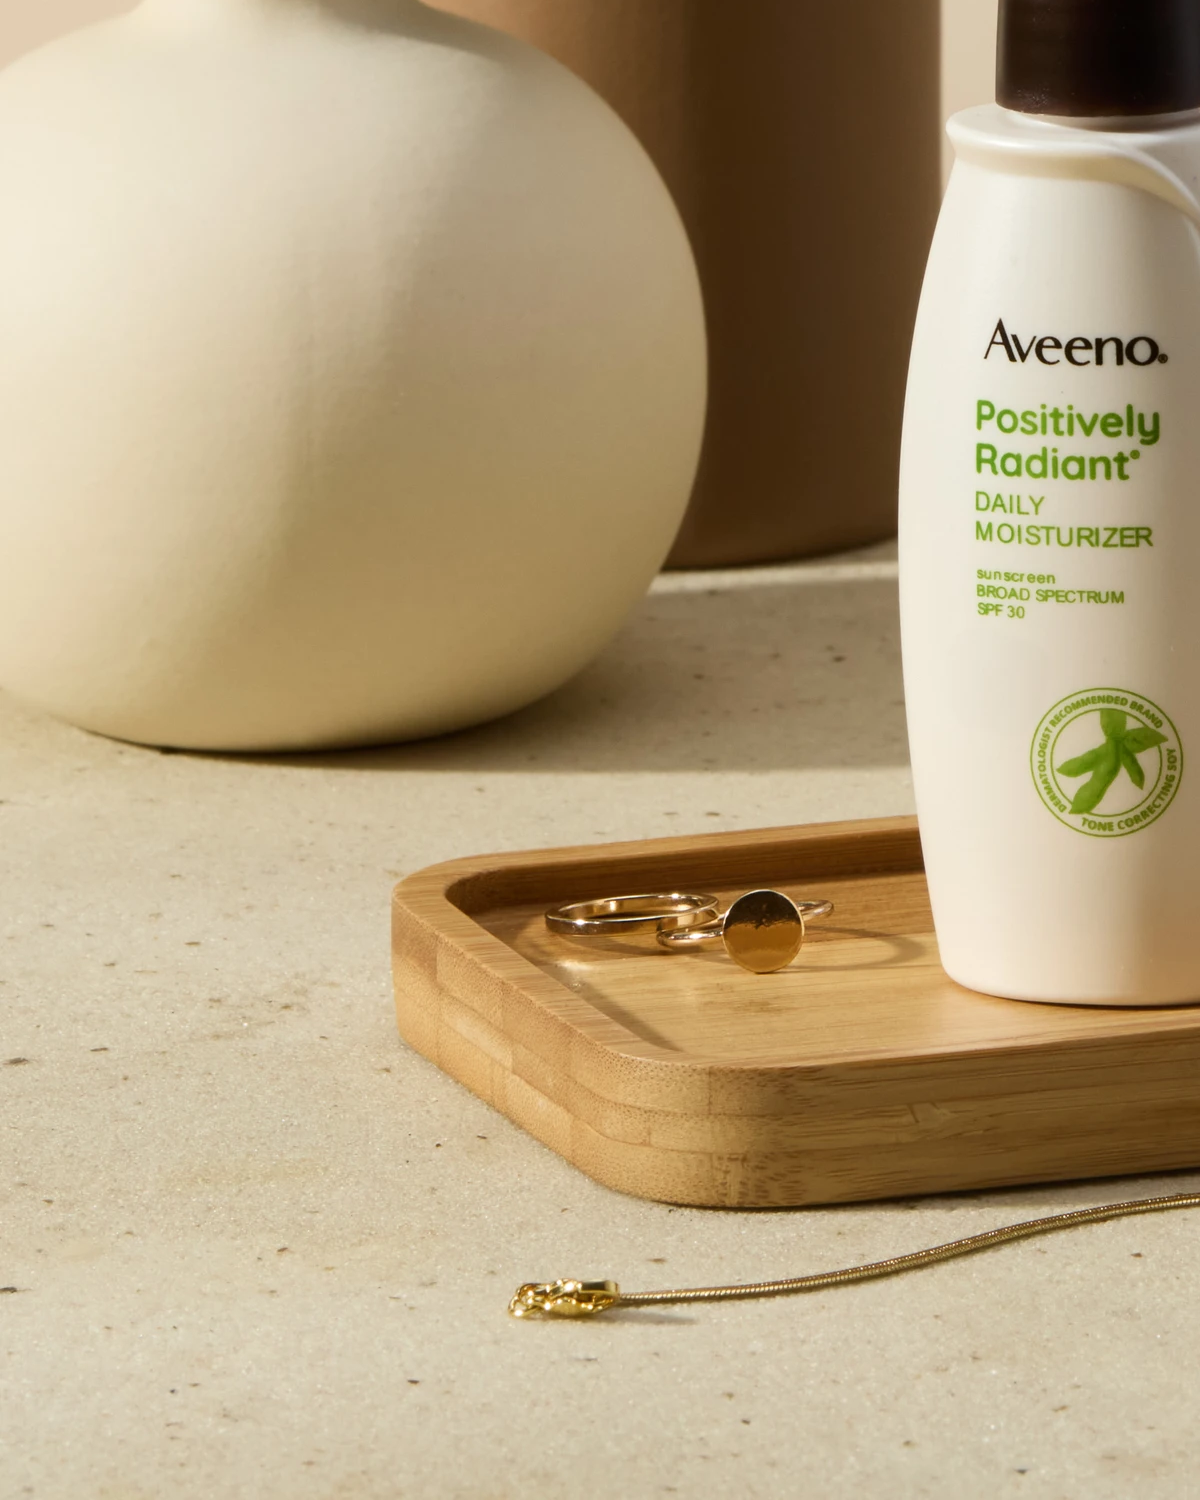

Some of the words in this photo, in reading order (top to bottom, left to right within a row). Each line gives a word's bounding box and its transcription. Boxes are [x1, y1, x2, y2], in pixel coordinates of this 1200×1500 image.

[975, 399, 1161, 445] Positively
[975, 490, 1045, 516] DAILY
[975, 520, 1154, 548] MOISTURIZER
[976, 569, 1056, 584] sunscreen
[976, 584, 1031, 601] BROAD
[1035, 588, 1125, 604] SPECTRUM
[977, 602, 1004, 616] SPF
[1007, 605, 1026, 619] 30
[1048, 694, 1129, 728] RECOMMENDED
[1129, 700, 1164, 730] BRAND
[1037, 726, 1068, 814] DERMATOLOGIST
[1081, 817, 1115, 832] TONE
[1117, 773, 1176, 831] CORRECTING
[1166, 747, 1178, 773] SOY
